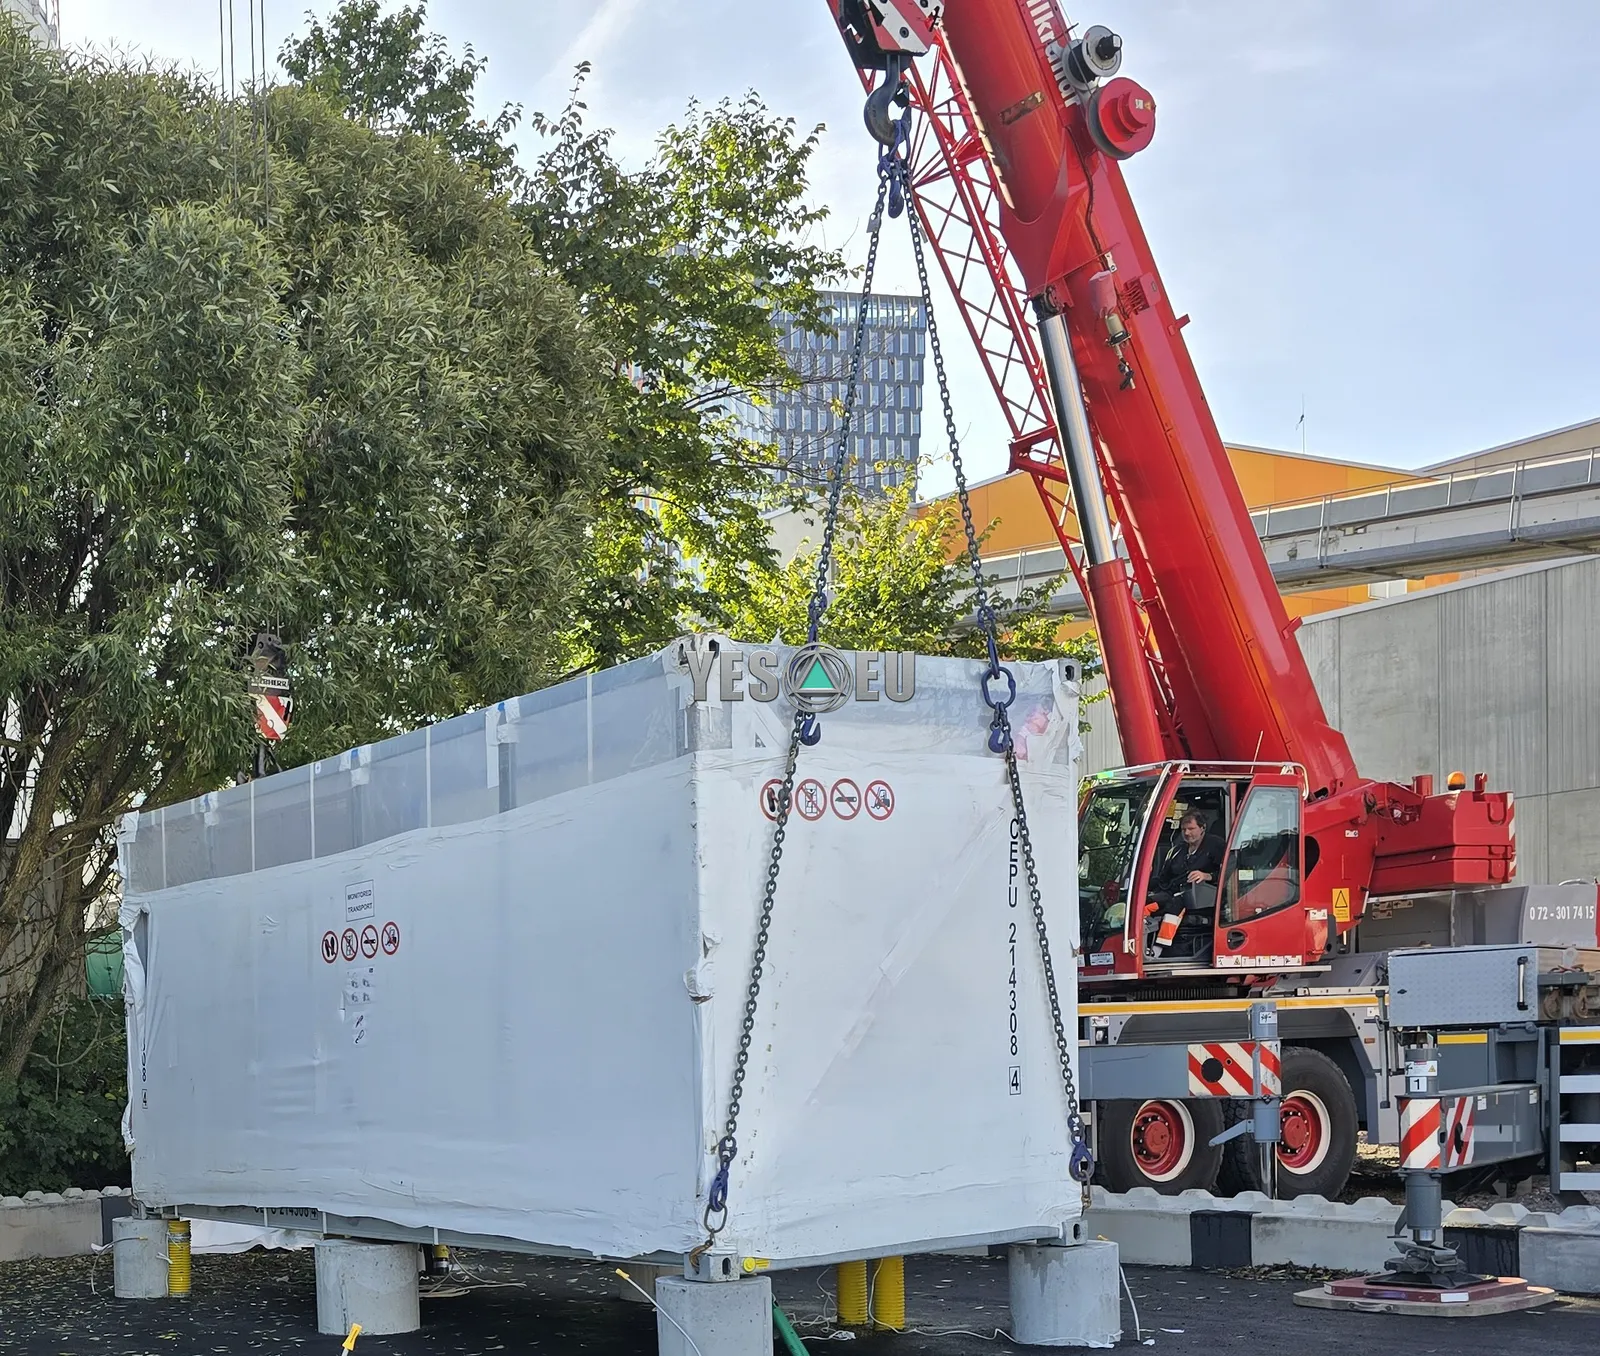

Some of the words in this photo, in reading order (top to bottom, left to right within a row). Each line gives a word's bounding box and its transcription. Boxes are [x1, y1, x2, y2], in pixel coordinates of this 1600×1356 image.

[1008, 818, 1019, 908] CEPU
[347, 889, 372, 900] MONITORED
[347, 902, 373, 913] TRANSPORT
[1008, 922, 1018, 1056] 214308
[1413, 1078, 1420, 1090] 1
